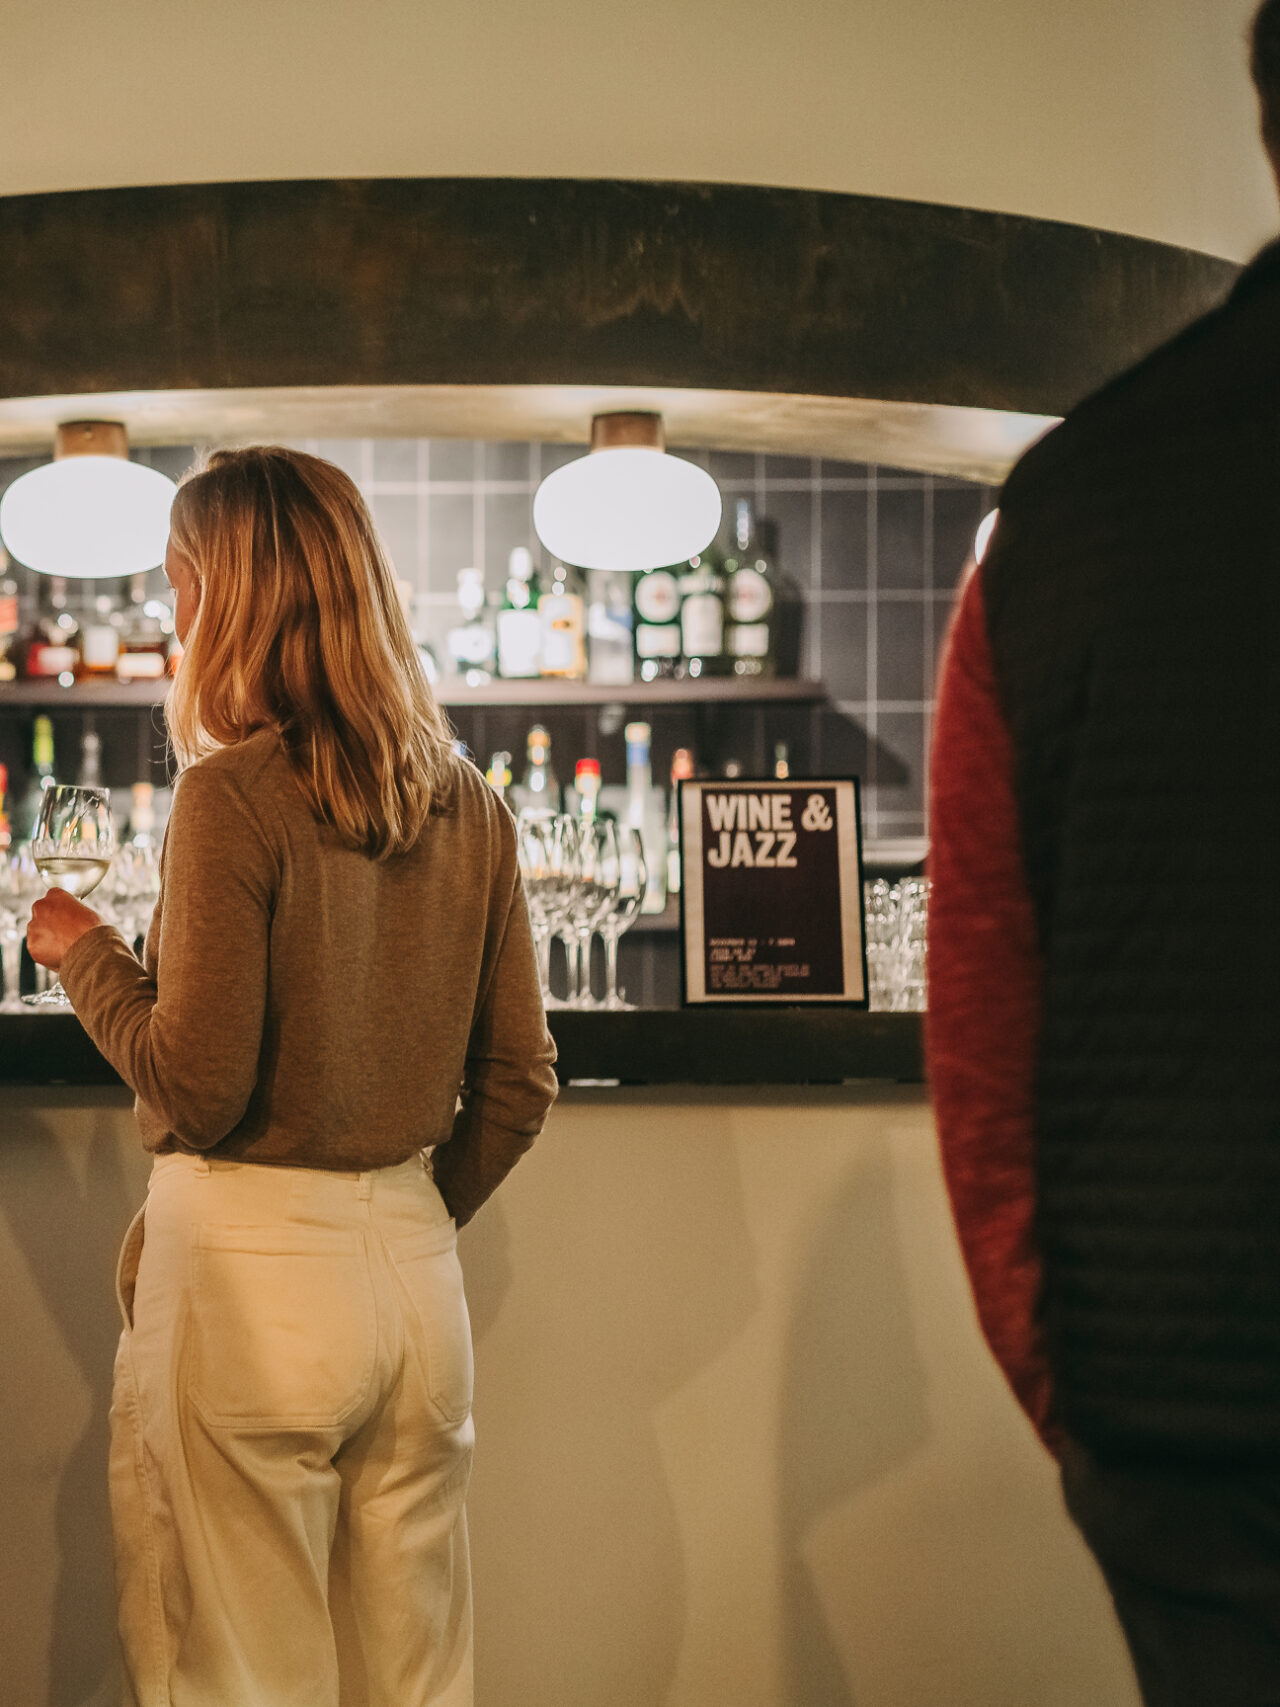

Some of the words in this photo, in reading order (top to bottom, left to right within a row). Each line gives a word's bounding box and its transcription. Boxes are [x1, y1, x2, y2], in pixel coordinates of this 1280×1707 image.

[706, 794, 793, 831] WINE
[801, 794, 833, 831] &
[707, 831, 798, 868] JAZZ
